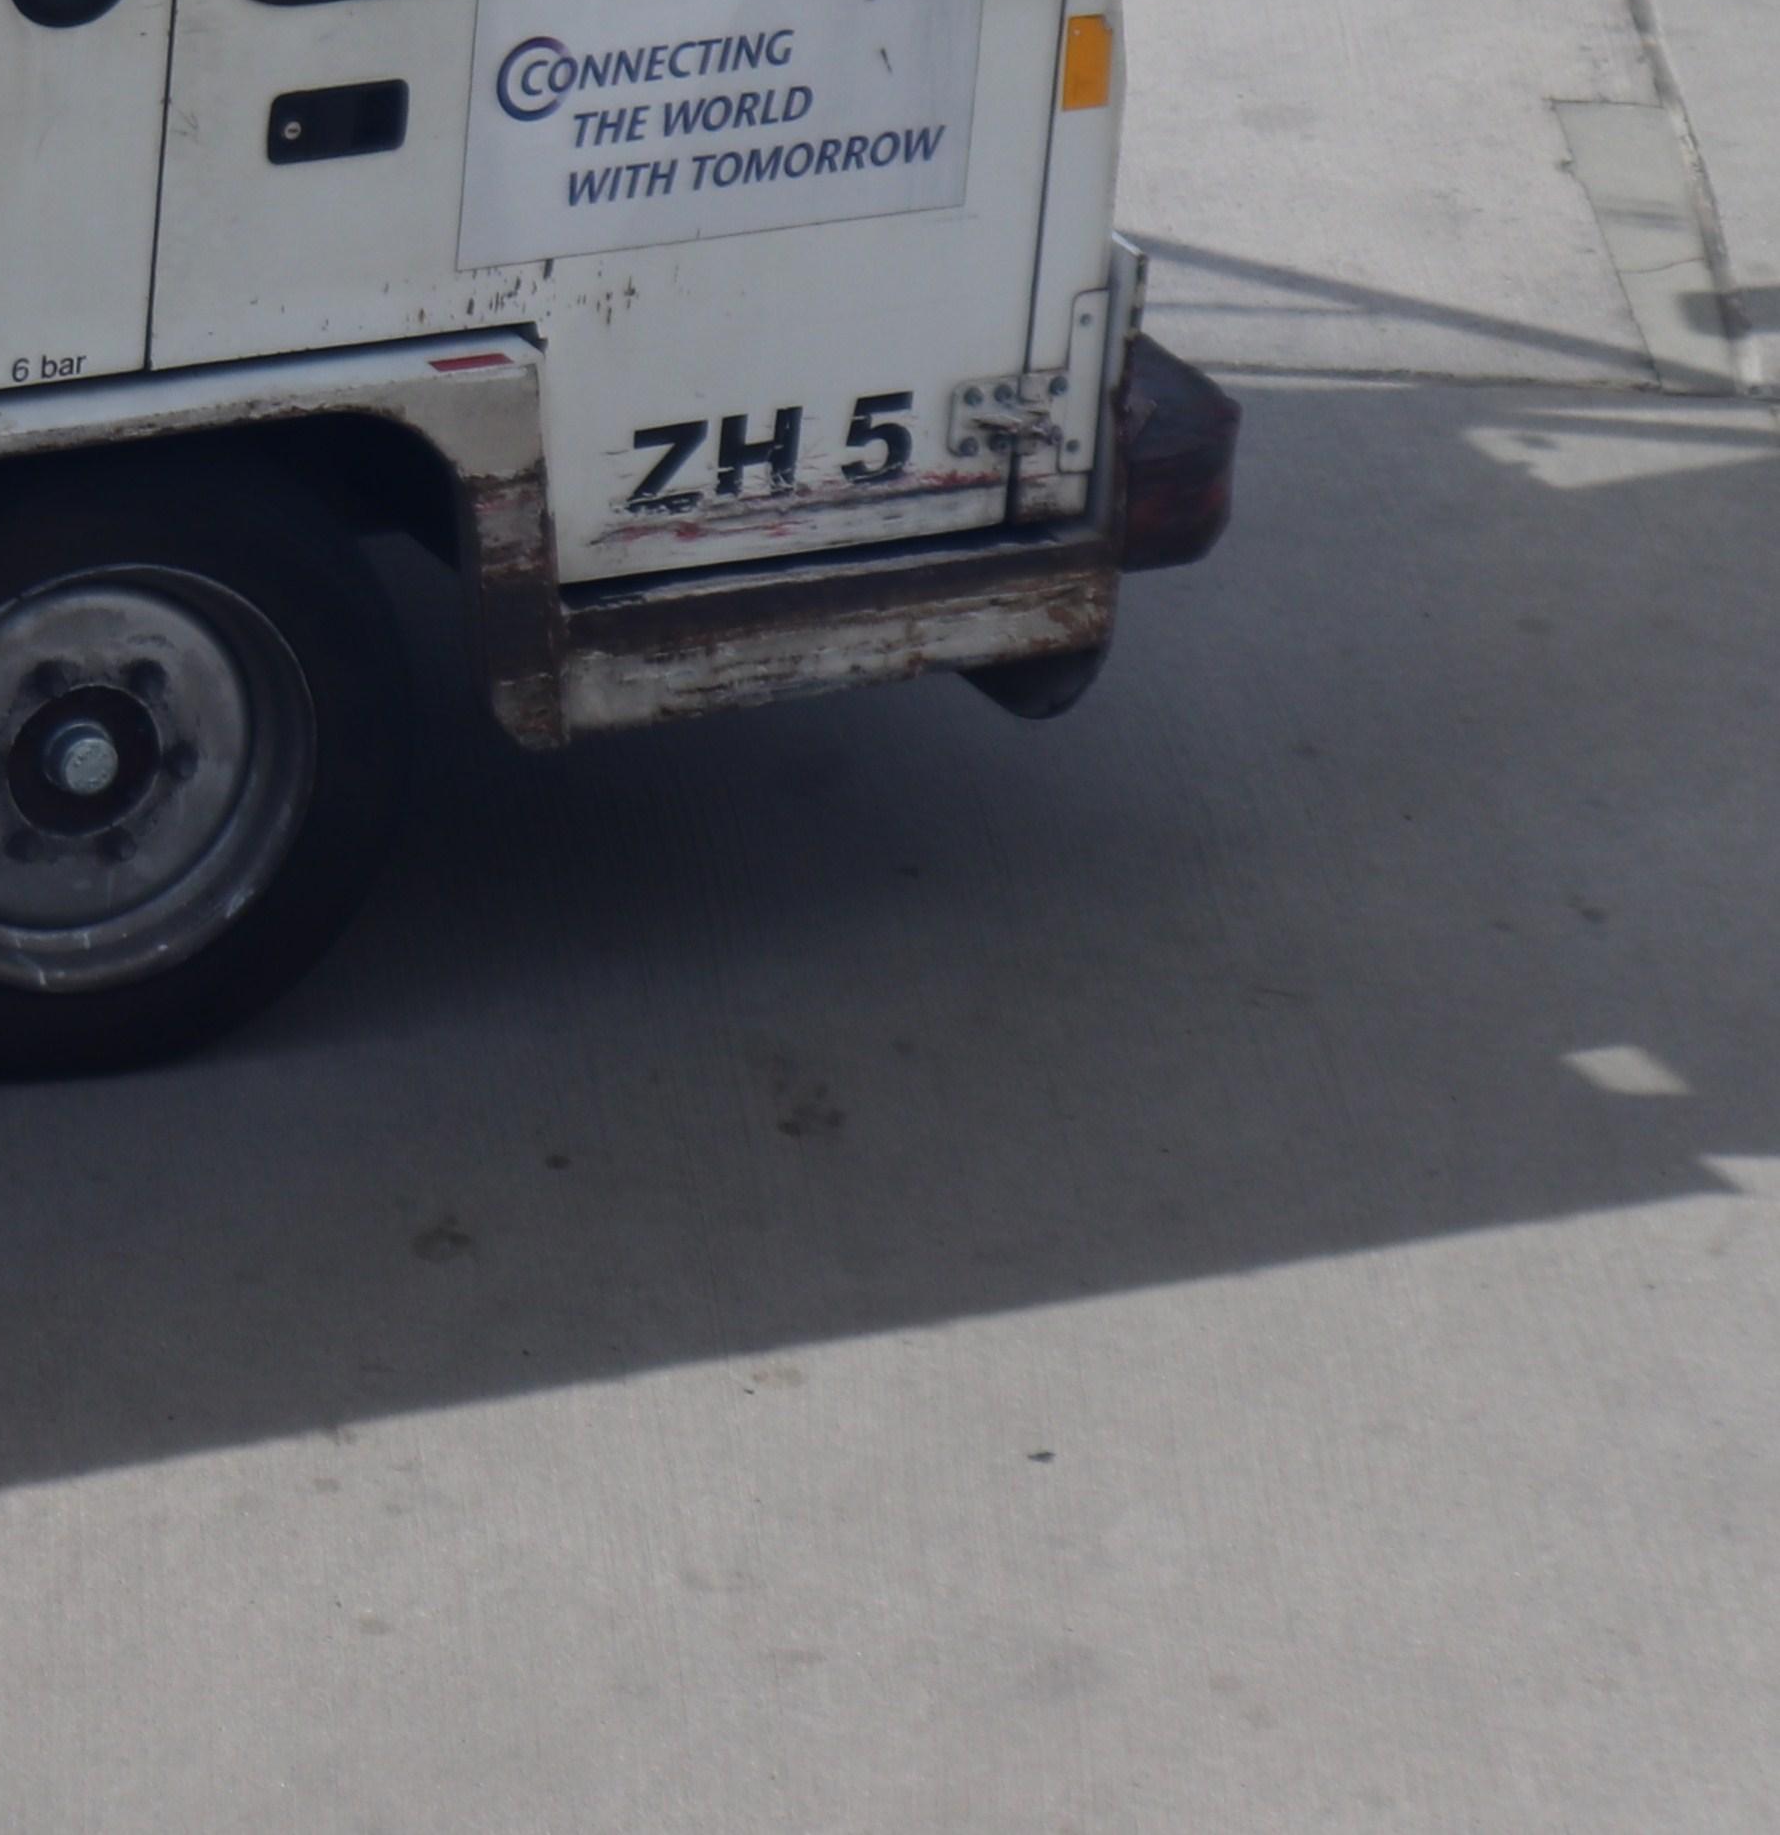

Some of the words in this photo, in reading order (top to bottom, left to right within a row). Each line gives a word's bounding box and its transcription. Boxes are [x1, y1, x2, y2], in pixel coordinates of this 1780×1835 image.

[497, 29, 795, 122] CONNECTING
[573, 105, 650, 148] THE
[663, 85, 814, 138] WORLD
[567, 159, 679, 207] WITH
[692, 124, 947, 191] TOMORROW
[11, 357, 30, 383] 6
[41, 354, 87, 379] bar
[626, 405, 804, 514] ZH
[840, 390, 915, 484] 5
